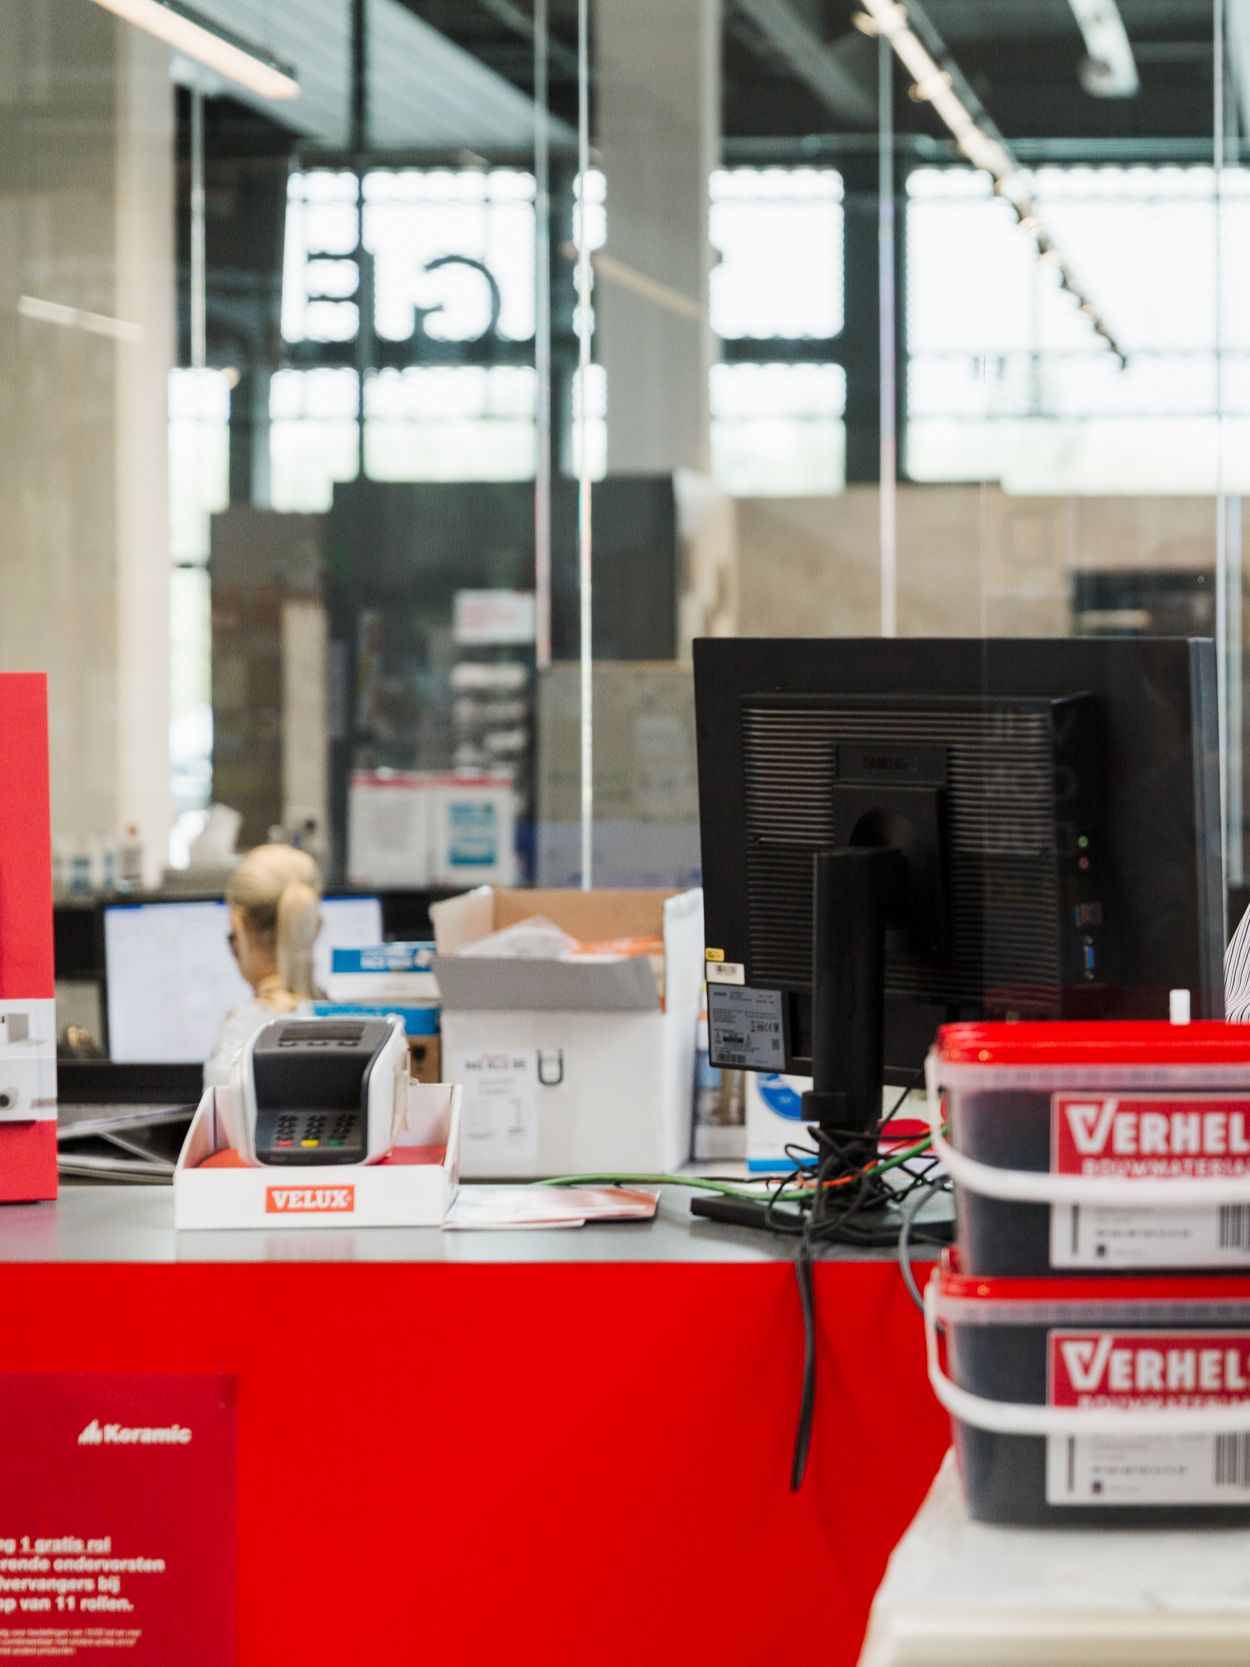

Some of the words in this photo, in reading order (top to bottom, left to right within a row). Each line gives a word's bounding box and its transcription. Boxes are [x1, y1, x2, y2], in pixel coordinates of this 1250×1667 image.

[271, 1189, 348, 1210] VELUX
[103, 1423, 192, 1445] Koramic
[20, 1536, 30, 1553] 1
[34, 1535, 84, 1555] gratis
[86, 1536, 110, 1554] rol
[53, 1555, 165, 1573] ondervorsten
[97, 1575, 121, 1595] bij
[19, 1598, 52, 1612] van
[54, 1595, 76, 1612] 11
[79, 1595, 135, 1612] rollen.
